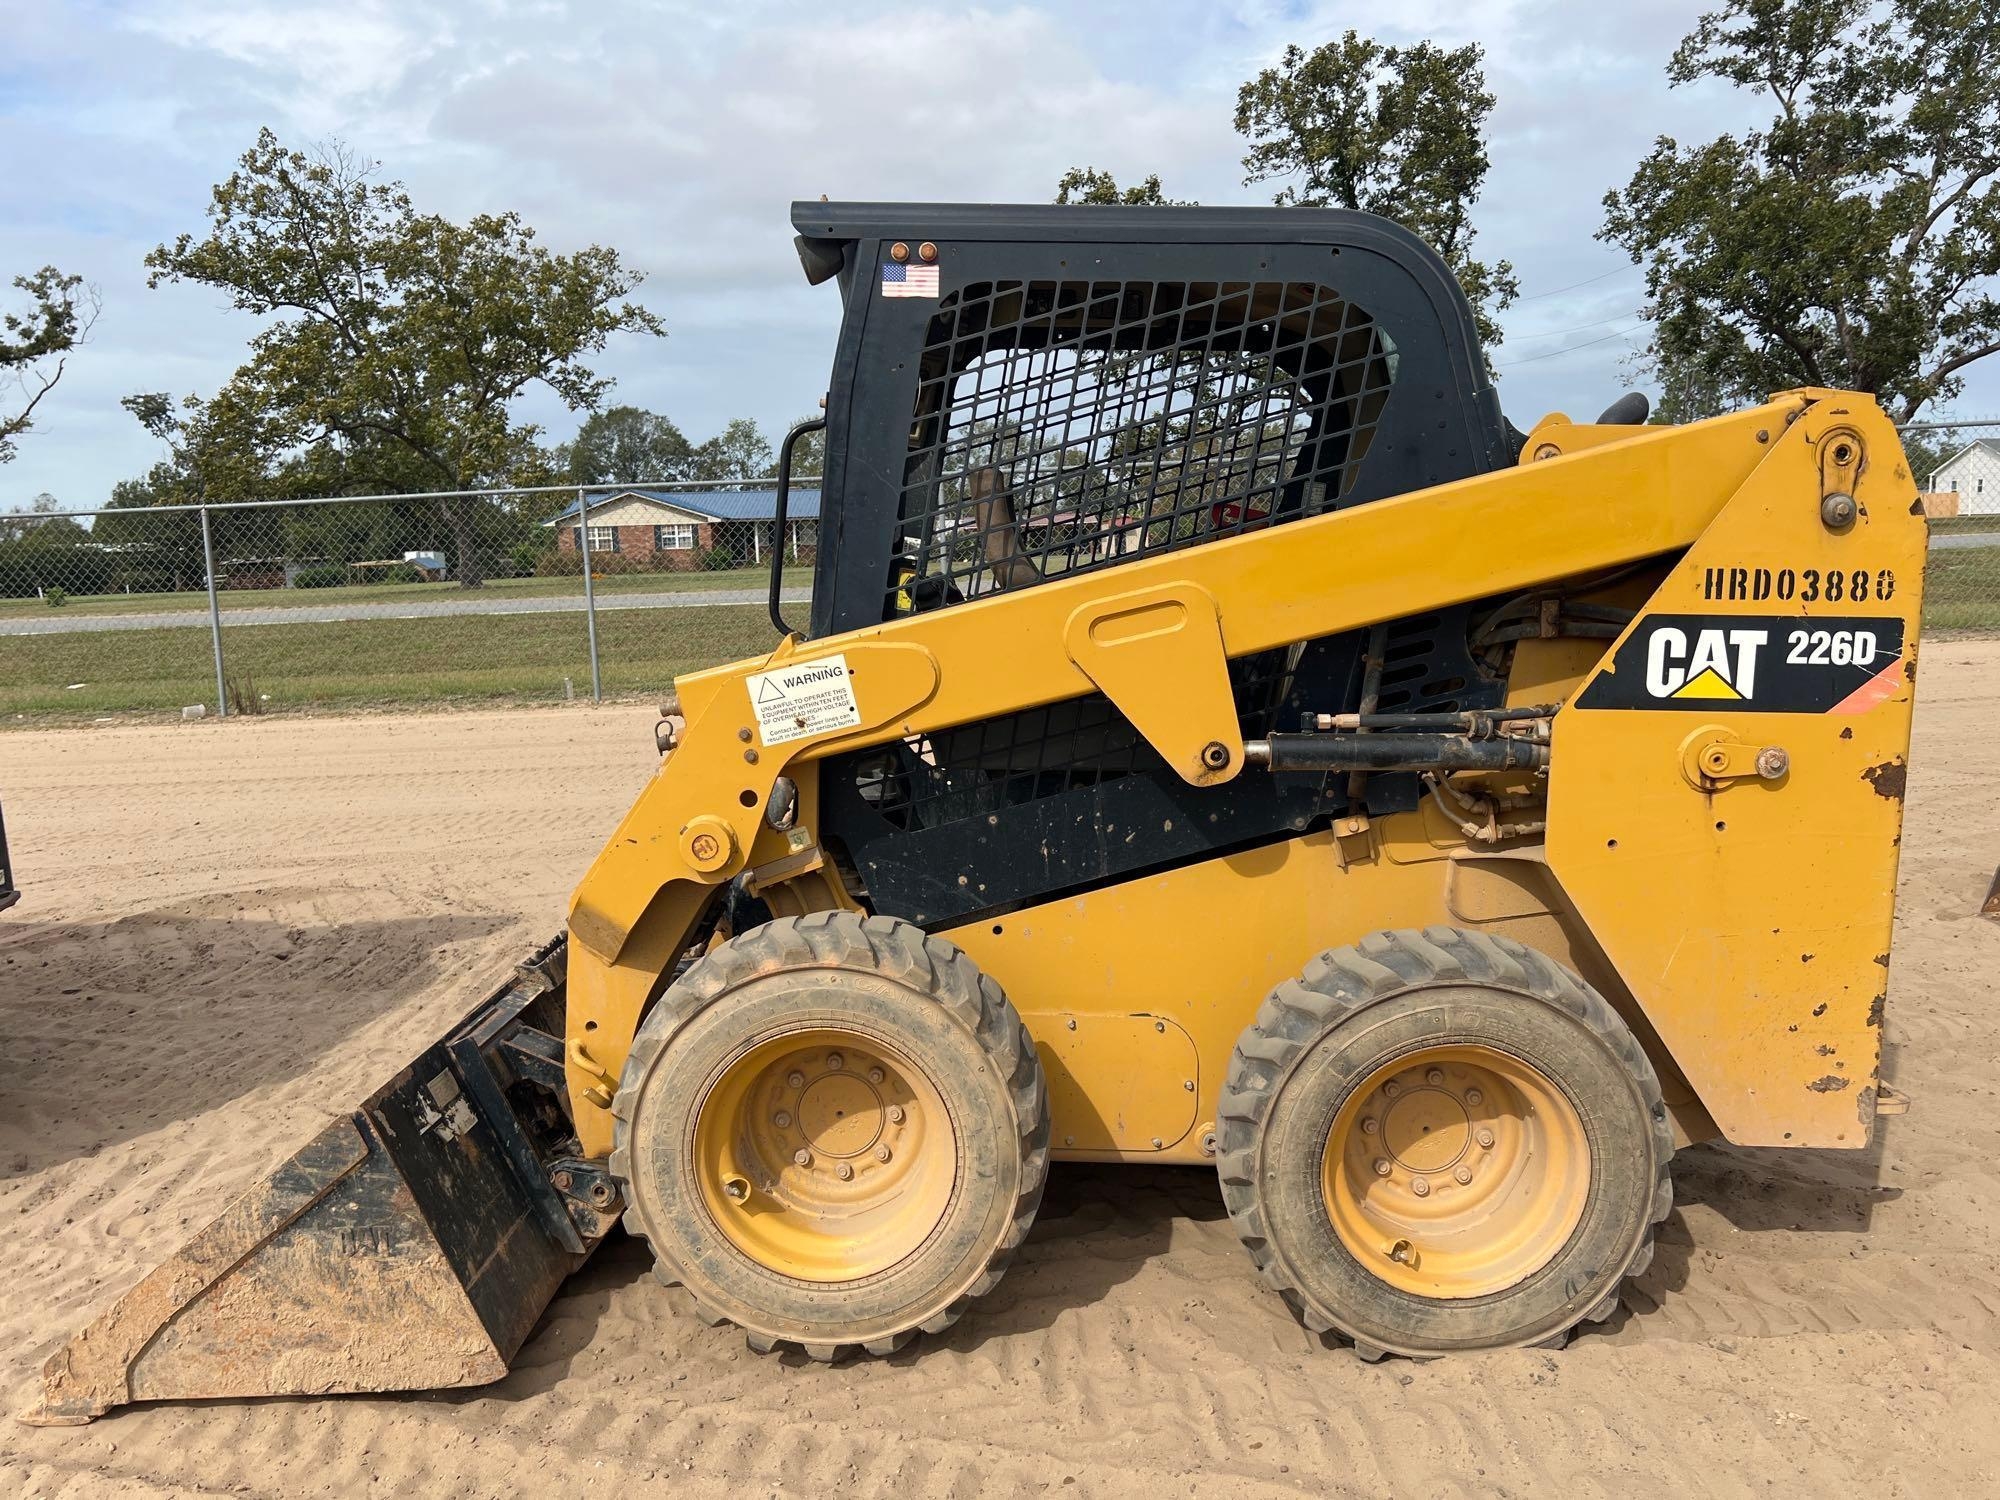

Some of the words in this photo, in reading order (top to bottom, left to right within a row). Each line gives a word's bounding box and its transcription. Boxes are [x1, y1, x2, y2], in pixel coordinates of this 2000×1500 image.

[1704, 567, 1897, 602] HRD03880
[1645, 627, 1768, 700] CAT
[1786, 630, 1876, 666] 226D
[784, 667, 843, 689] WARNING
[761, 701, 794, 713] UNLAWFUL
[804, 692, 832, 702] OPERATE
[763, 707, 797, 719] EQUIPMENT
[798, 701, 819, 710] WITHIN
[773, 711, 806, 723] OVERHEAD
[770, 727, 793, 736] Contact
[816, 723, 837, 731] serious
